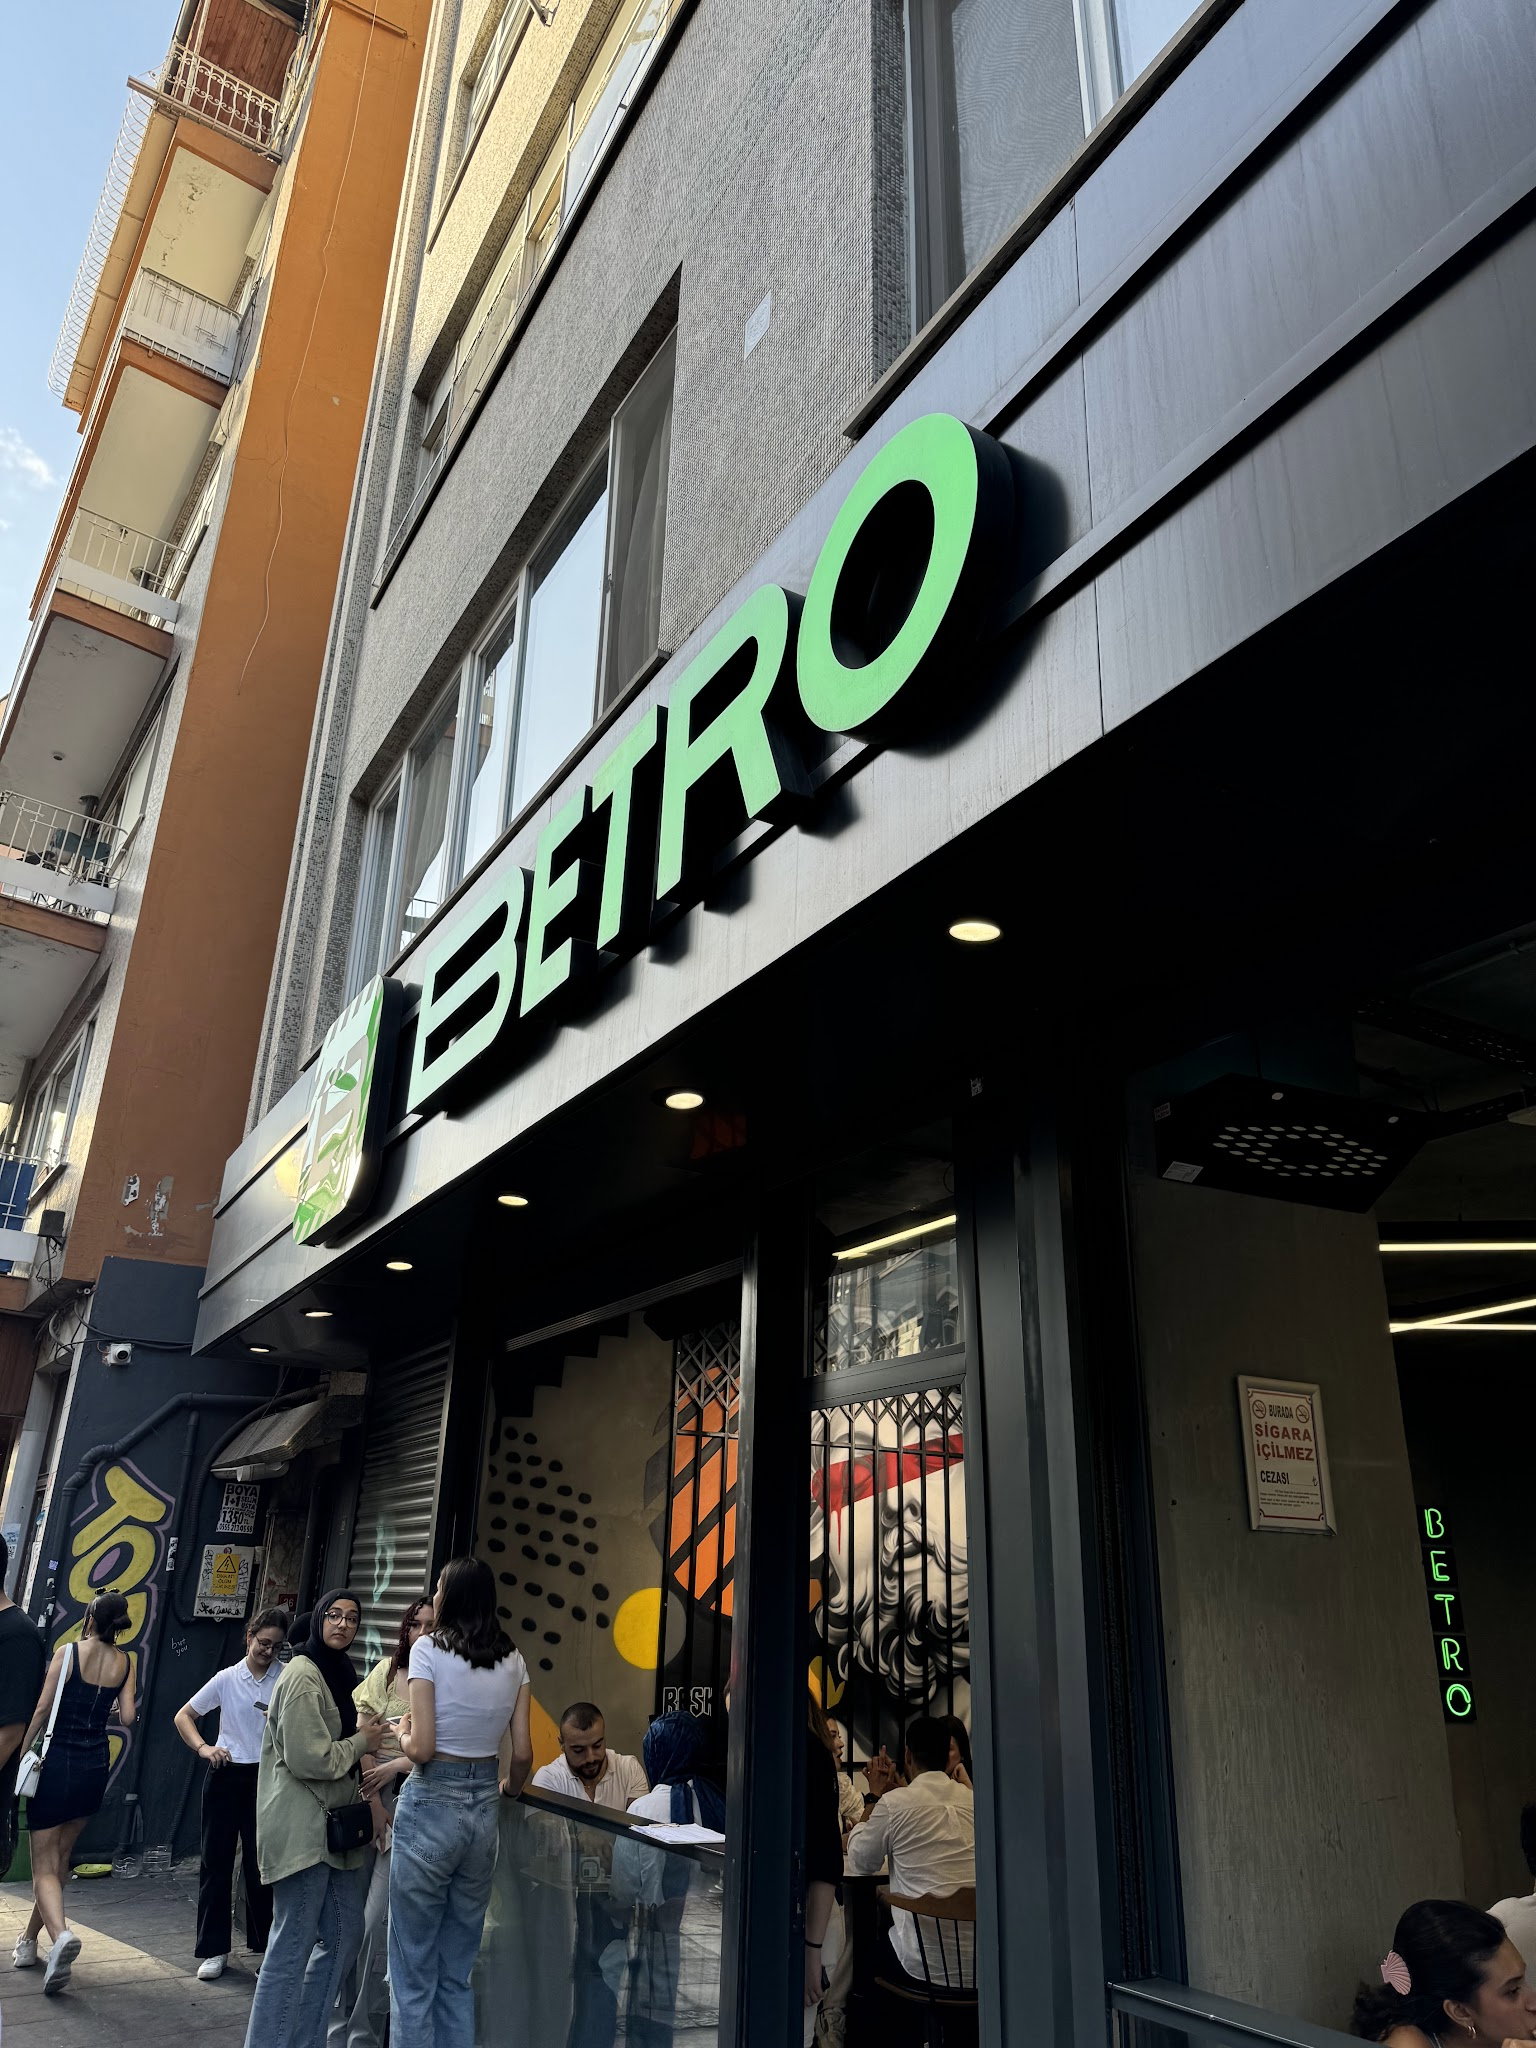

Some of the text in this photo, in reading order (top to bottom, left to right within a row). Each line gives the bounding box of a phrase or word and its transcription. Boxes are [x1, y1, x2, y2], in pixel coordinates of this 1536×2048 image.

[407, 412, 979, 1115] BETRO
[1269, 1404, 1293, 1419] BURADA
[1255, 1421, 1312, 1442] SİGARA
[1256, 1439, 1315, 1461] İÇİLMEZ
[1260, 1470, 1290, 1485] CEZASI
[226, 1484, 257, 1497] BOYA
[222, 1510, 244, 1524] 1350
[1424, 1507, 1471, 1717] BETRO
[176, 1645, 189, 1657] you
